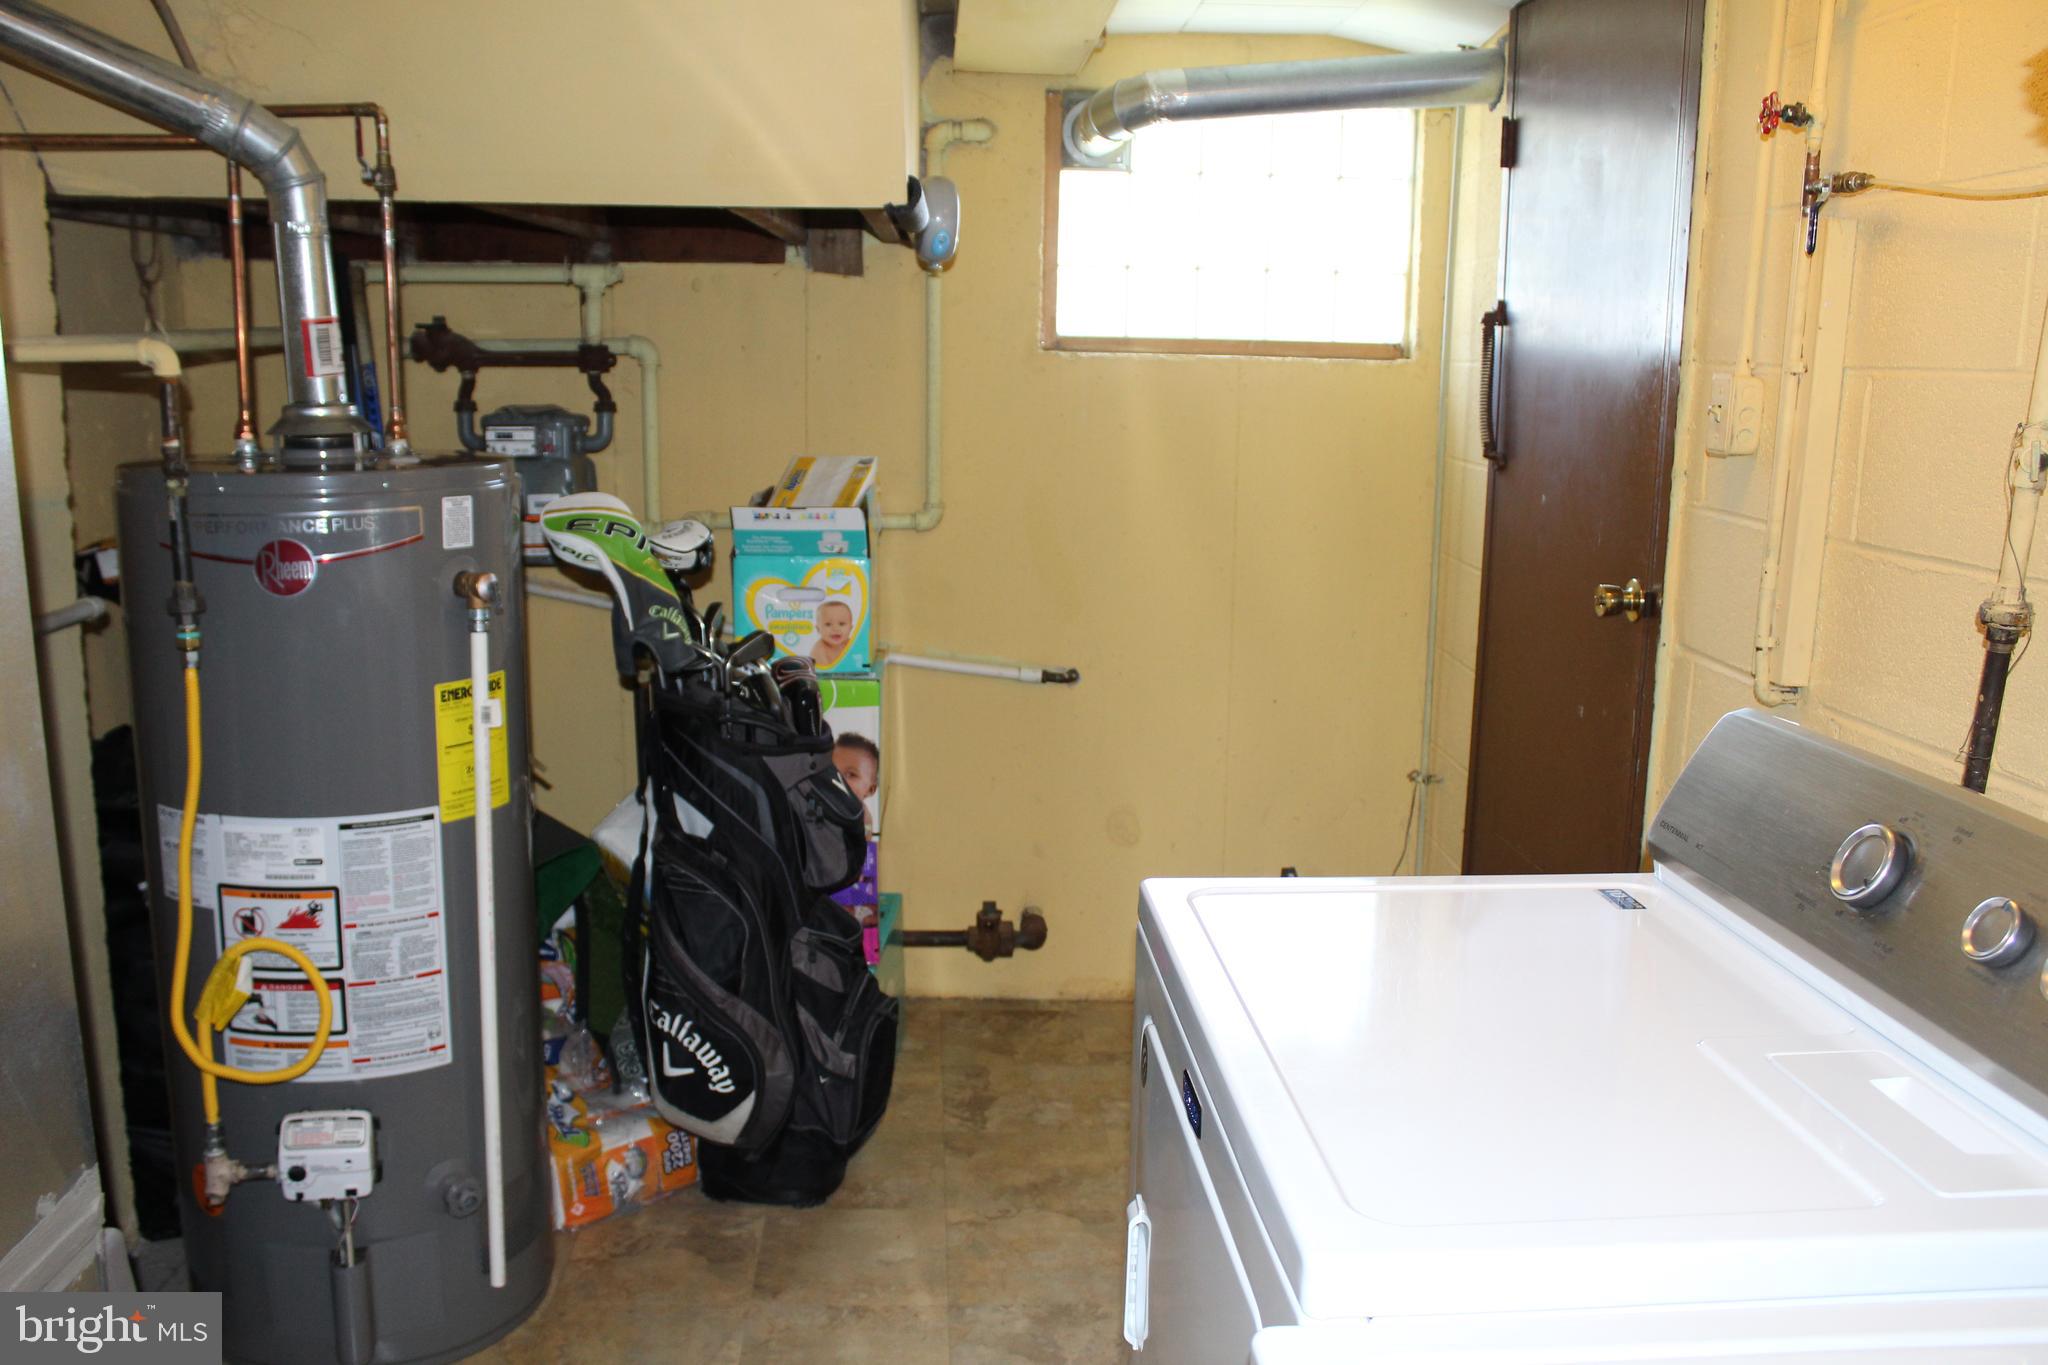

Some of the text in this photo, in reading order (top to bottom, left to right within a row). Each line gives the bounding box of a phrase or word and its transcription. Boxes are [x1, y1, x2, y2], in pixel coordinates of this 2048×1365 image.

[332, 515, 376, 533] PLUS
[565, 518, 647, 551] EPI
[258, 541, 313, 589] Rheem
[765, 603, 813, 621] Pampers
[648, 999, 735, 1093] Callaway
